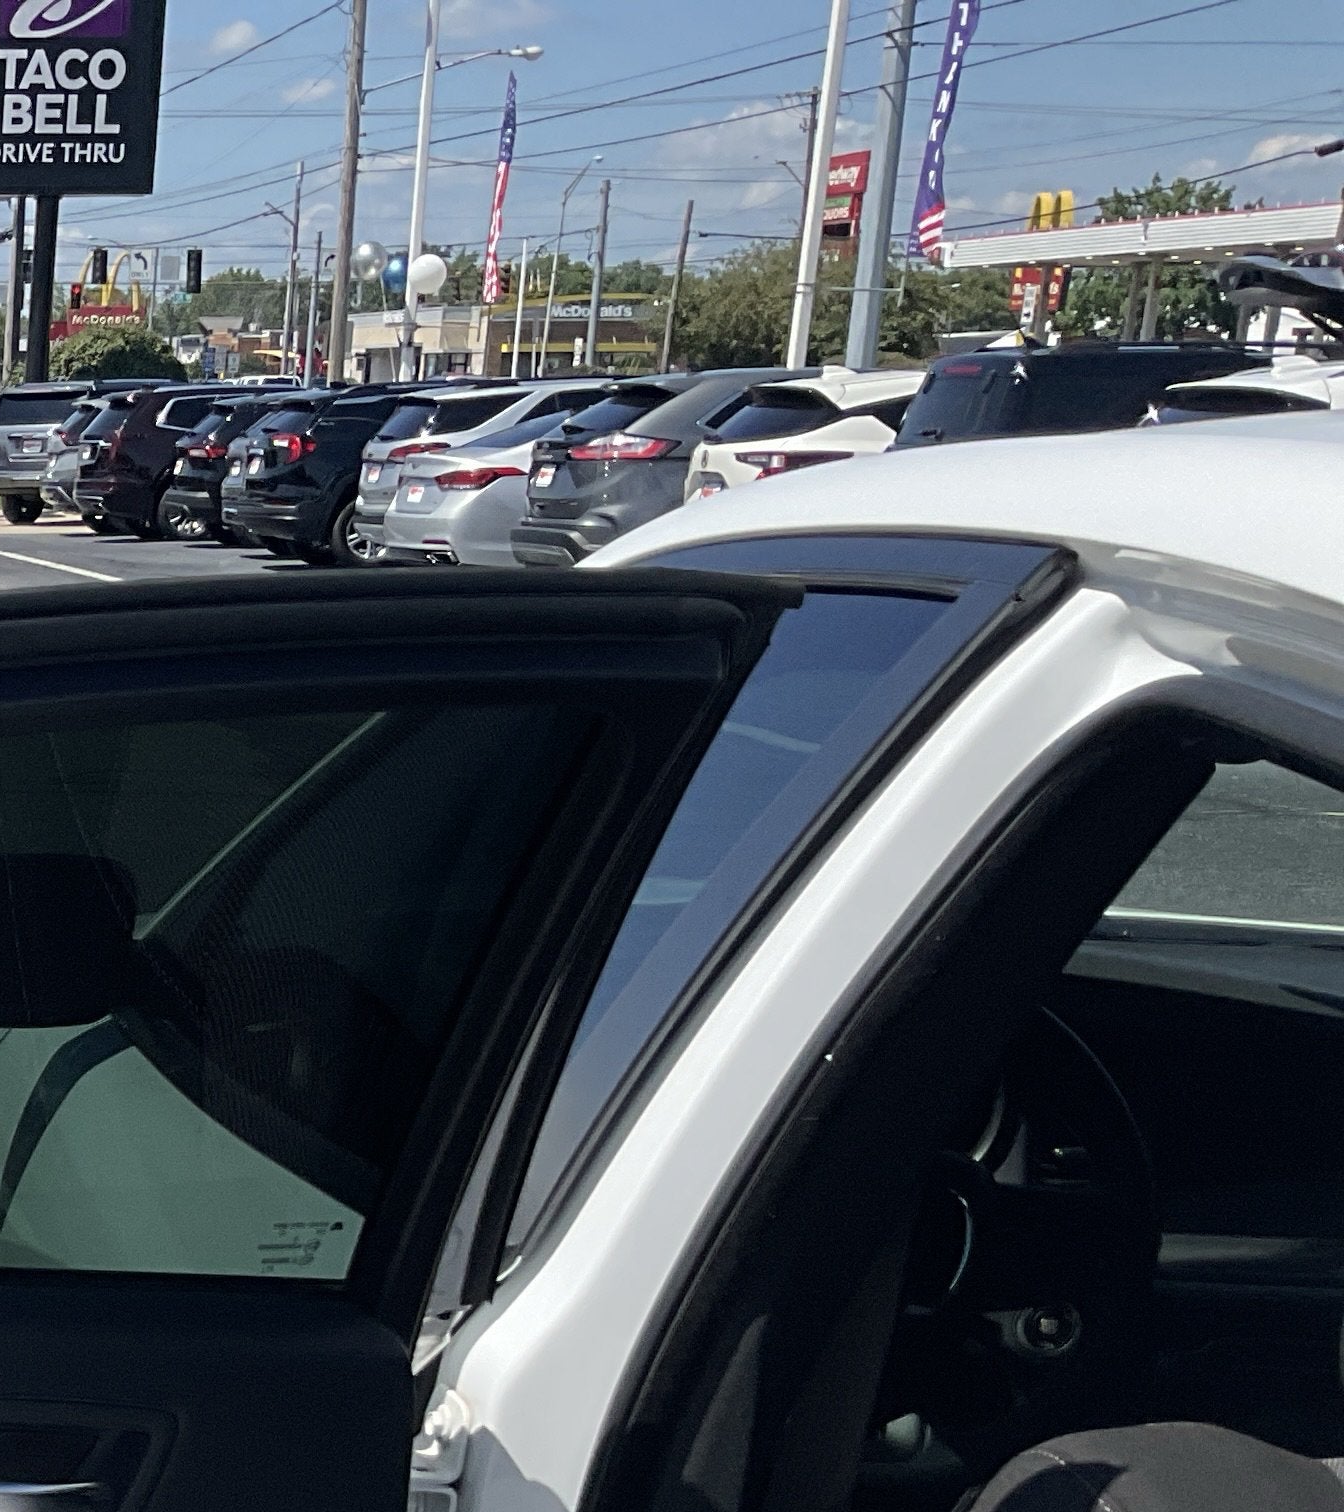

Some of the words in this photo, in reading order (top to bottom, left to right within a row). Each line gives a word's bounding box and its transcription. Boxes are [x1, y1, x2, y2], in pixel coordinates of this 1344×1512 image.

[1, 94, 121, 134] BELL
[60, 142, 126, 164] THRU
[550, 303, 633, 318] McDoald's
